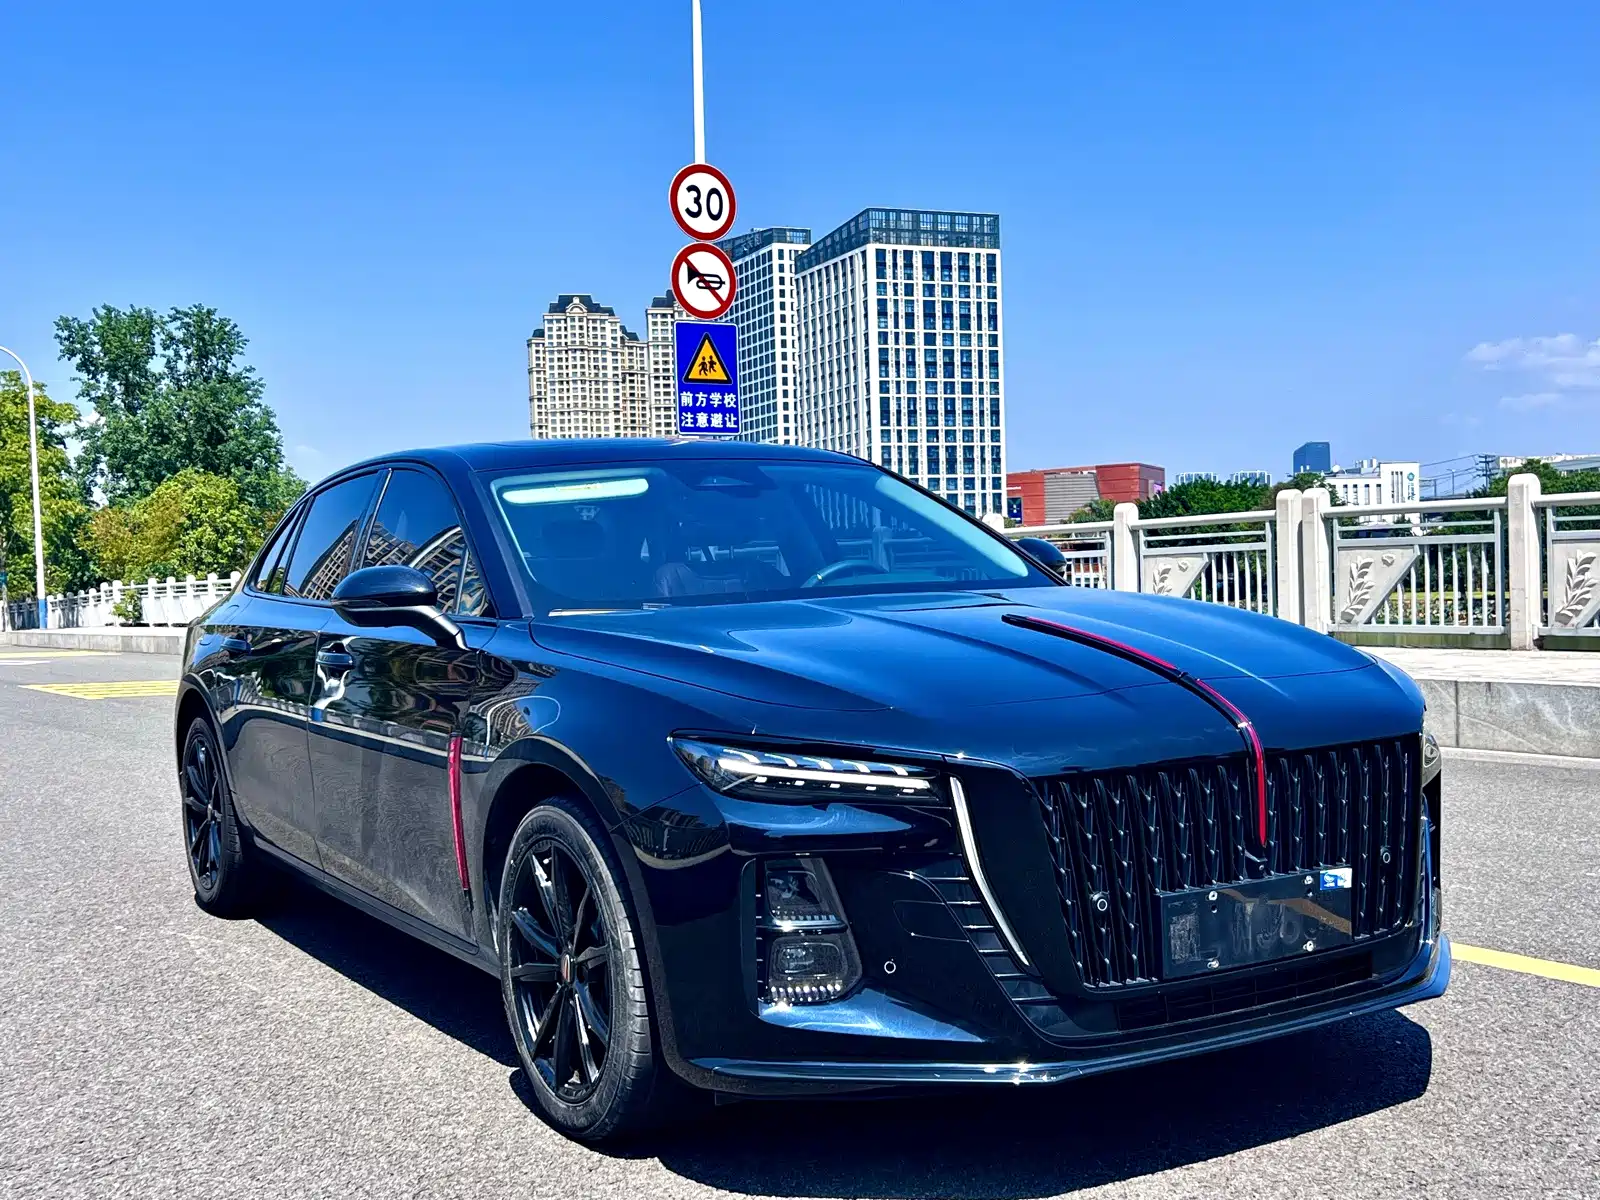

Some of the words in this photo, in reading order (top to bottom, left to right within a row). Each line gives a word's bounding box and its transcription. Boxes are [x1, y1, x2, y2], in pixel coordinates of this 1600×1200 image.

[685, 184, 724, 221] 30
[680, 391, 737, 408] 前方学校
[681, 412, 738, 428] 注意避让
